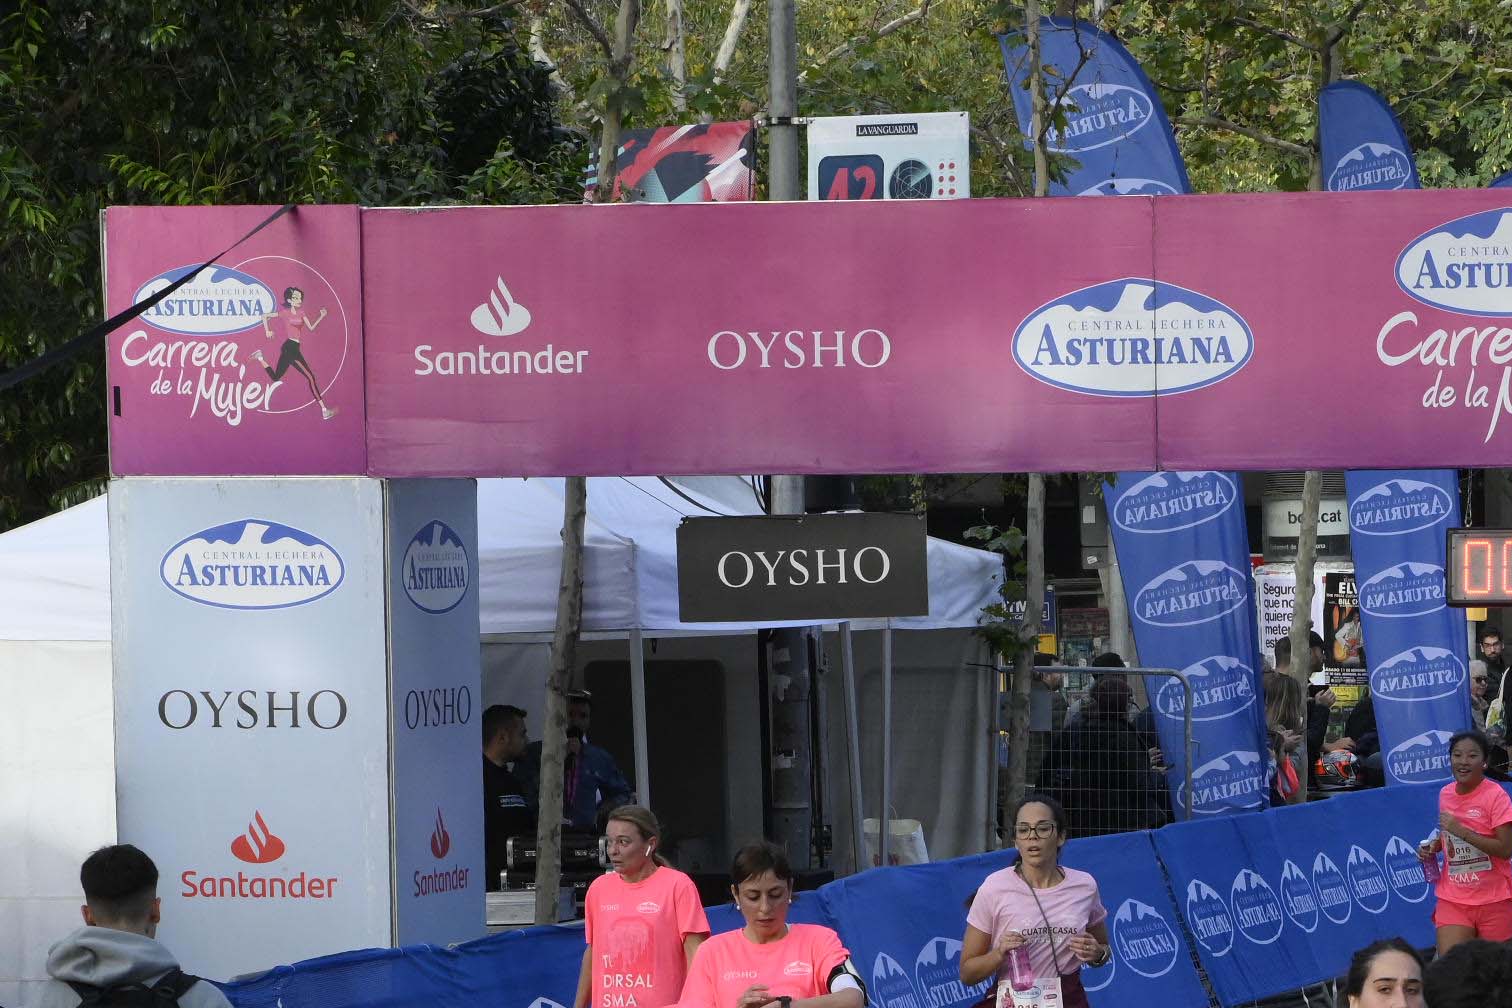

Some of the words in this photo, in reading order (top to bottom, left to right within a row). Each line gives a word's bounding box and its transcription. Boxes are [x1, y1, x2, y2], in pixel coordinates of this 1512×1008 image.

[167, 288, 209, 298] ENTRAL
[1068, 320, 1142, 332] CENTRAL
[1150, 319, 1227, 331] LECHERA
[121, 332, 237, 368] Carrera
[415, 345, 588, 375] Santander
[707, 329, 891, 370] OYSHO
[1031, 323, 1234, 366] ASTURIANA
[150, 369, 174, 395] de
[178, 369, 192, 395] la
[191, 362, 283, 426] Mujer
[1422, 371, 1457, 409] de
[1464, 371, 1489, 409] la
[175, 553, 331, 587] ASTURIANA
[203, 551, 261, 560] CENTRAL
[266, 551, 325, 560] LECHERA
[717, 546, 890, 588] OYSHO
[408, 559, 466, 592] ASTURIANA
[1264, 599, 1280, 608] que
[158, 689, 347, 730] OYSHO
[405, 685, 470, 730] OYSHO
[181, 871, 337, 899] Santander
[413, 864, 469, 898] Santander
[1022, 927, 1077, 936] CUATRECASAS
